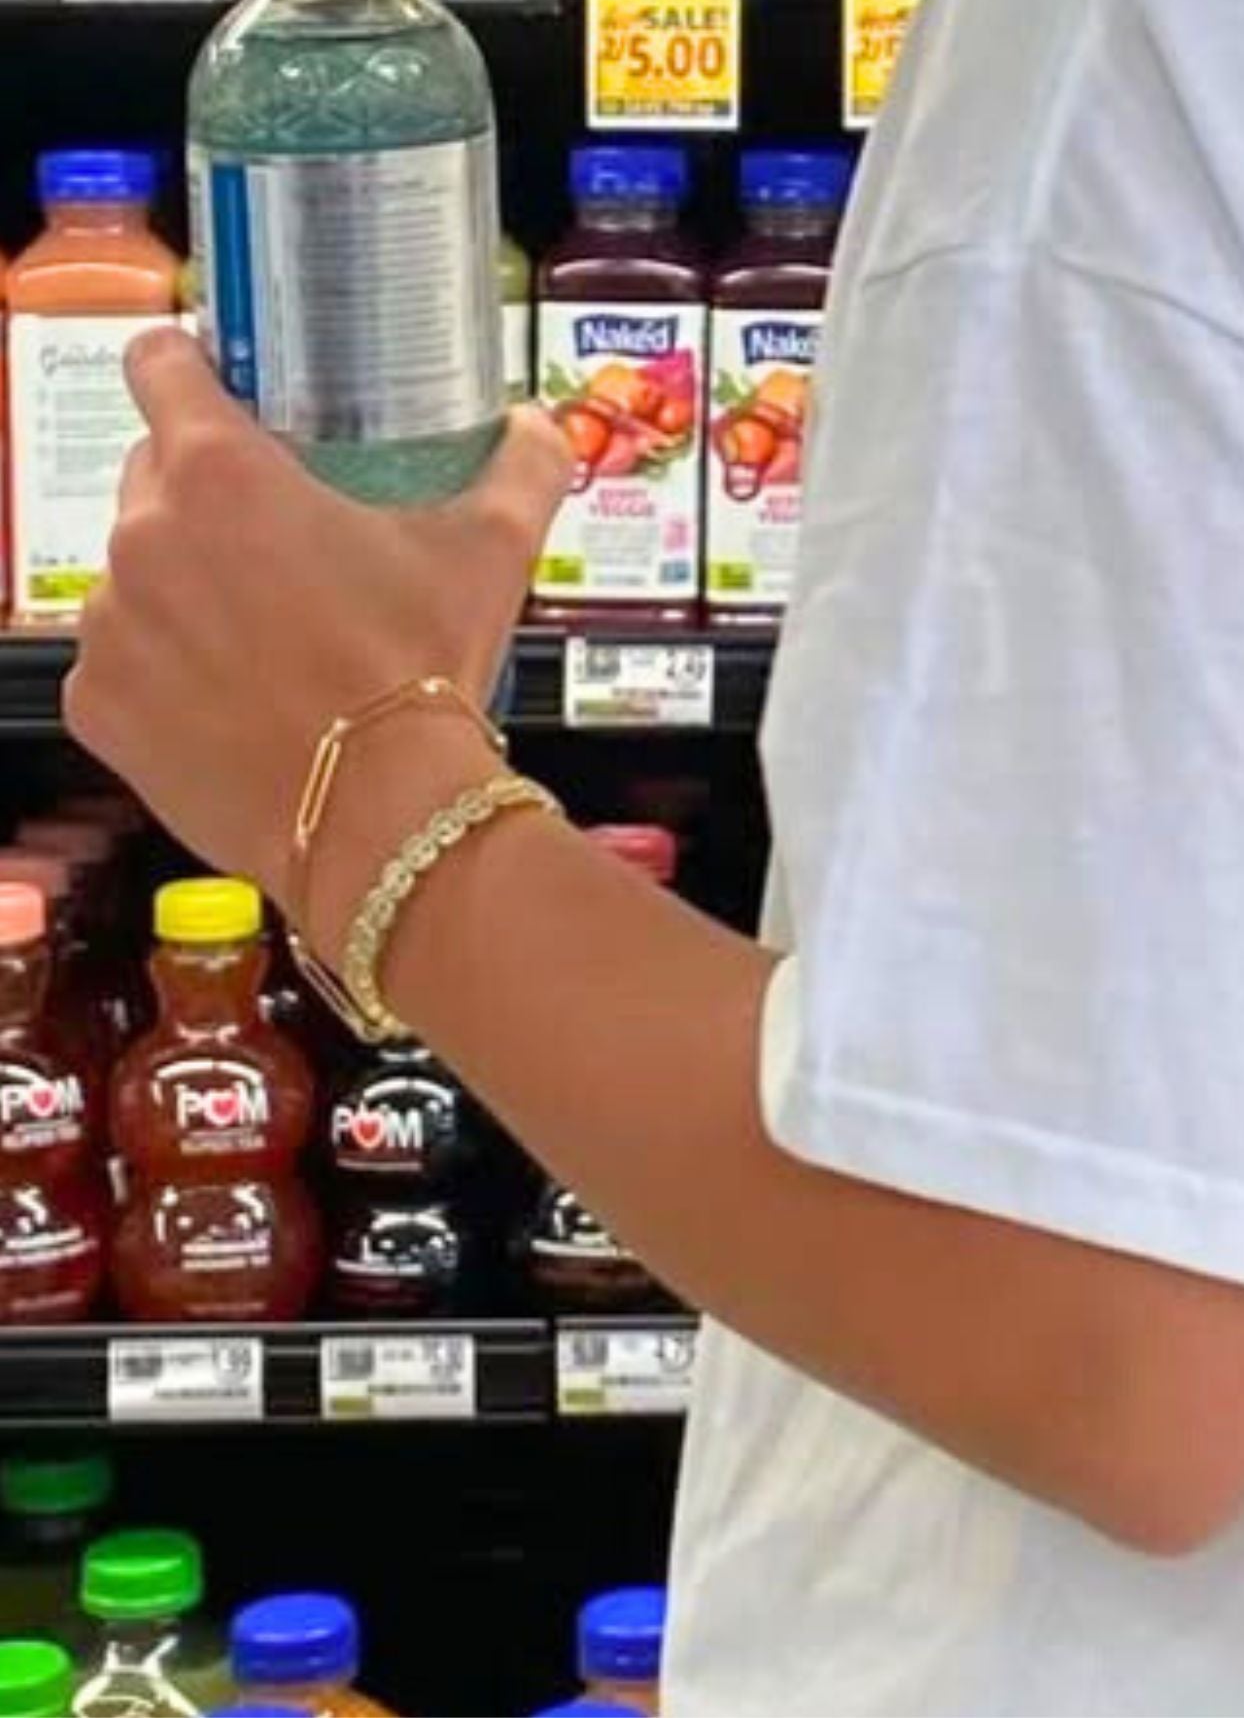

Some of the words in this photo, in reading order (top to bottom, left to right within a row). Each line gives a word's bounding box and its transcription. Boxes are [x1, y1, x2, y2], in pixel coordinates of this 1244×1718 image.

[643, 5, 729, 31] SALE!
[580, 318, 670, 352] Naked
[0, 1076, 84, 1124] POM
[175, 1079, 269, 1131] POM
[331, 1102, 424, 1151] POM
